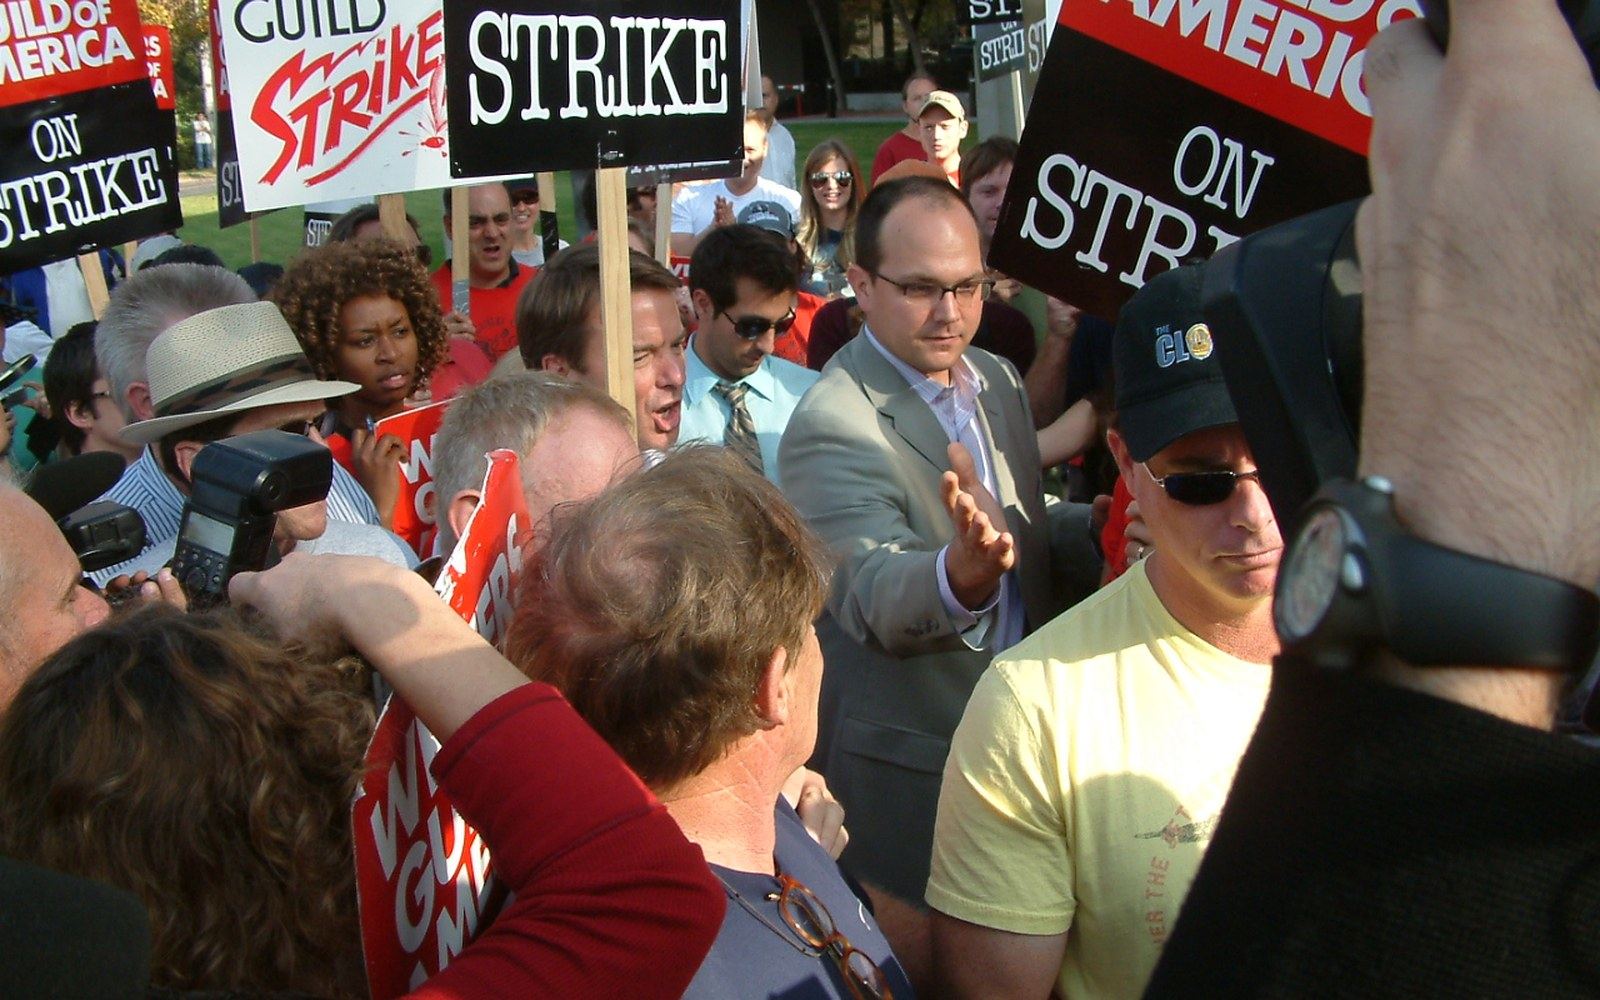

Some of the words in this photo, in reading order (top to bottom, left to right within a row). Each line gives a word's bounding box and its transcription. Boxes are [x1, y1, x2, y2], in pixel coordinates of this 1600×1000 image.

[74, 0, 111, 28] OF
[234, 0, 386, 43] GUILD
[144, 35, 161, 57] S
[469, 10, 728, 126] STRIKE
[32, 114, 82, 163] ON
[1174, 126, 1275, 218] ON
[1155, 324, 1170, 336] THE
[1144, 855, 1171, 899] THE
